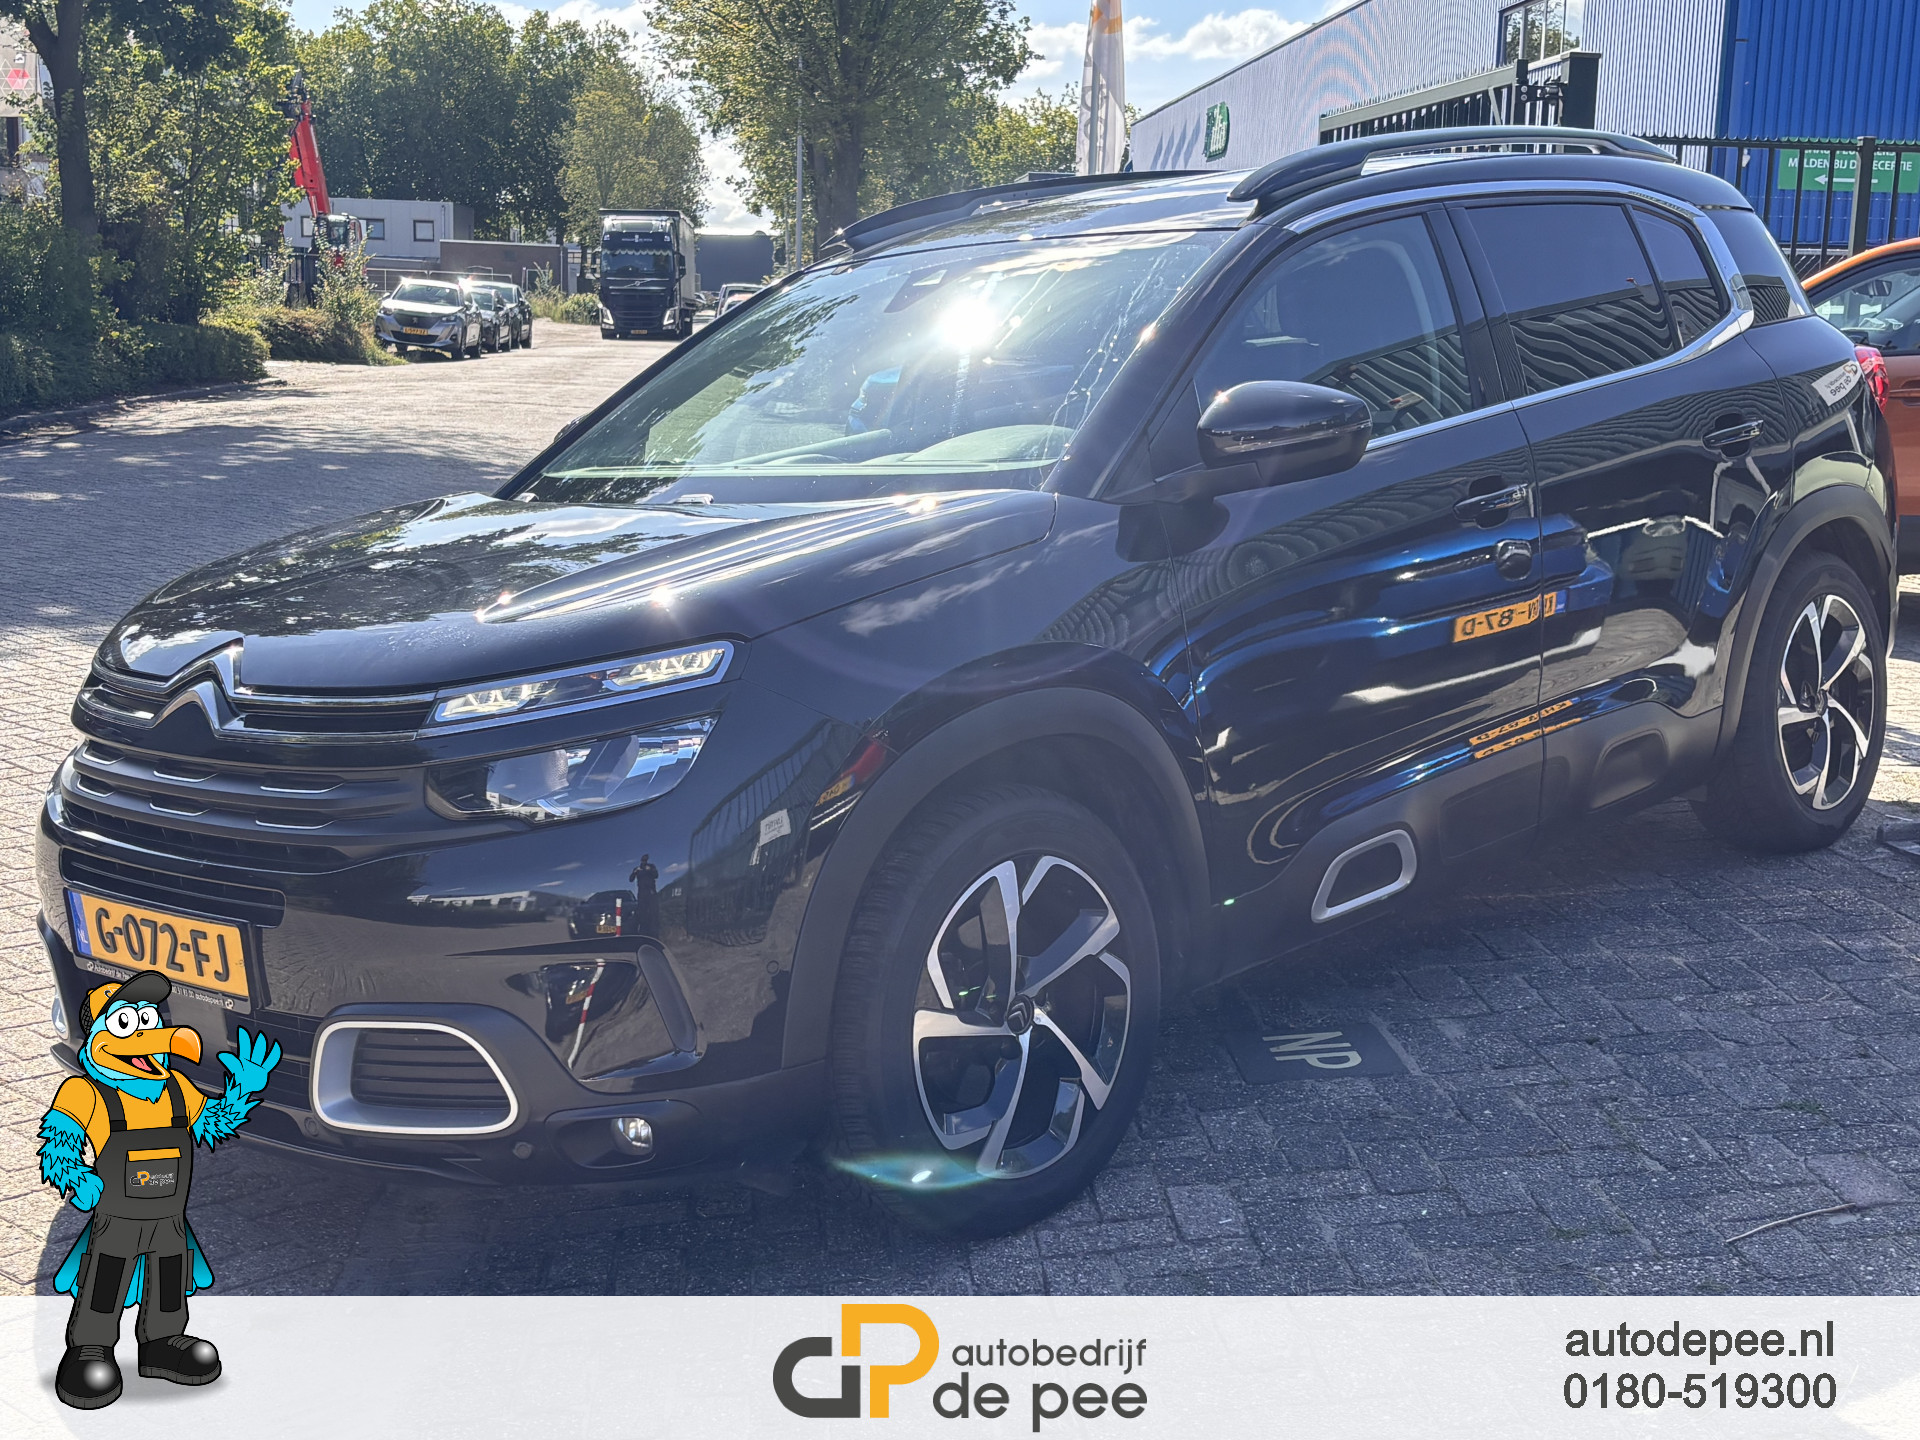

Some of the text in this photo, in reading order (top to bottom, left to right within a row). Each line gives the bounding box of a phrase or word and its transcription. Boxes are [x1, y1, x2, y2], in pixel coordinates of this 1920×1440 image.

[1788, 157, 1830, 170] MLDEN
[1833, 158, 1848, 170] BIJ
[1866, 160, 1913, 172] ECEPTIE
[95, 907, 230, 983] G-072-FJ
[1262, 1031, 1363, 1070] NP
